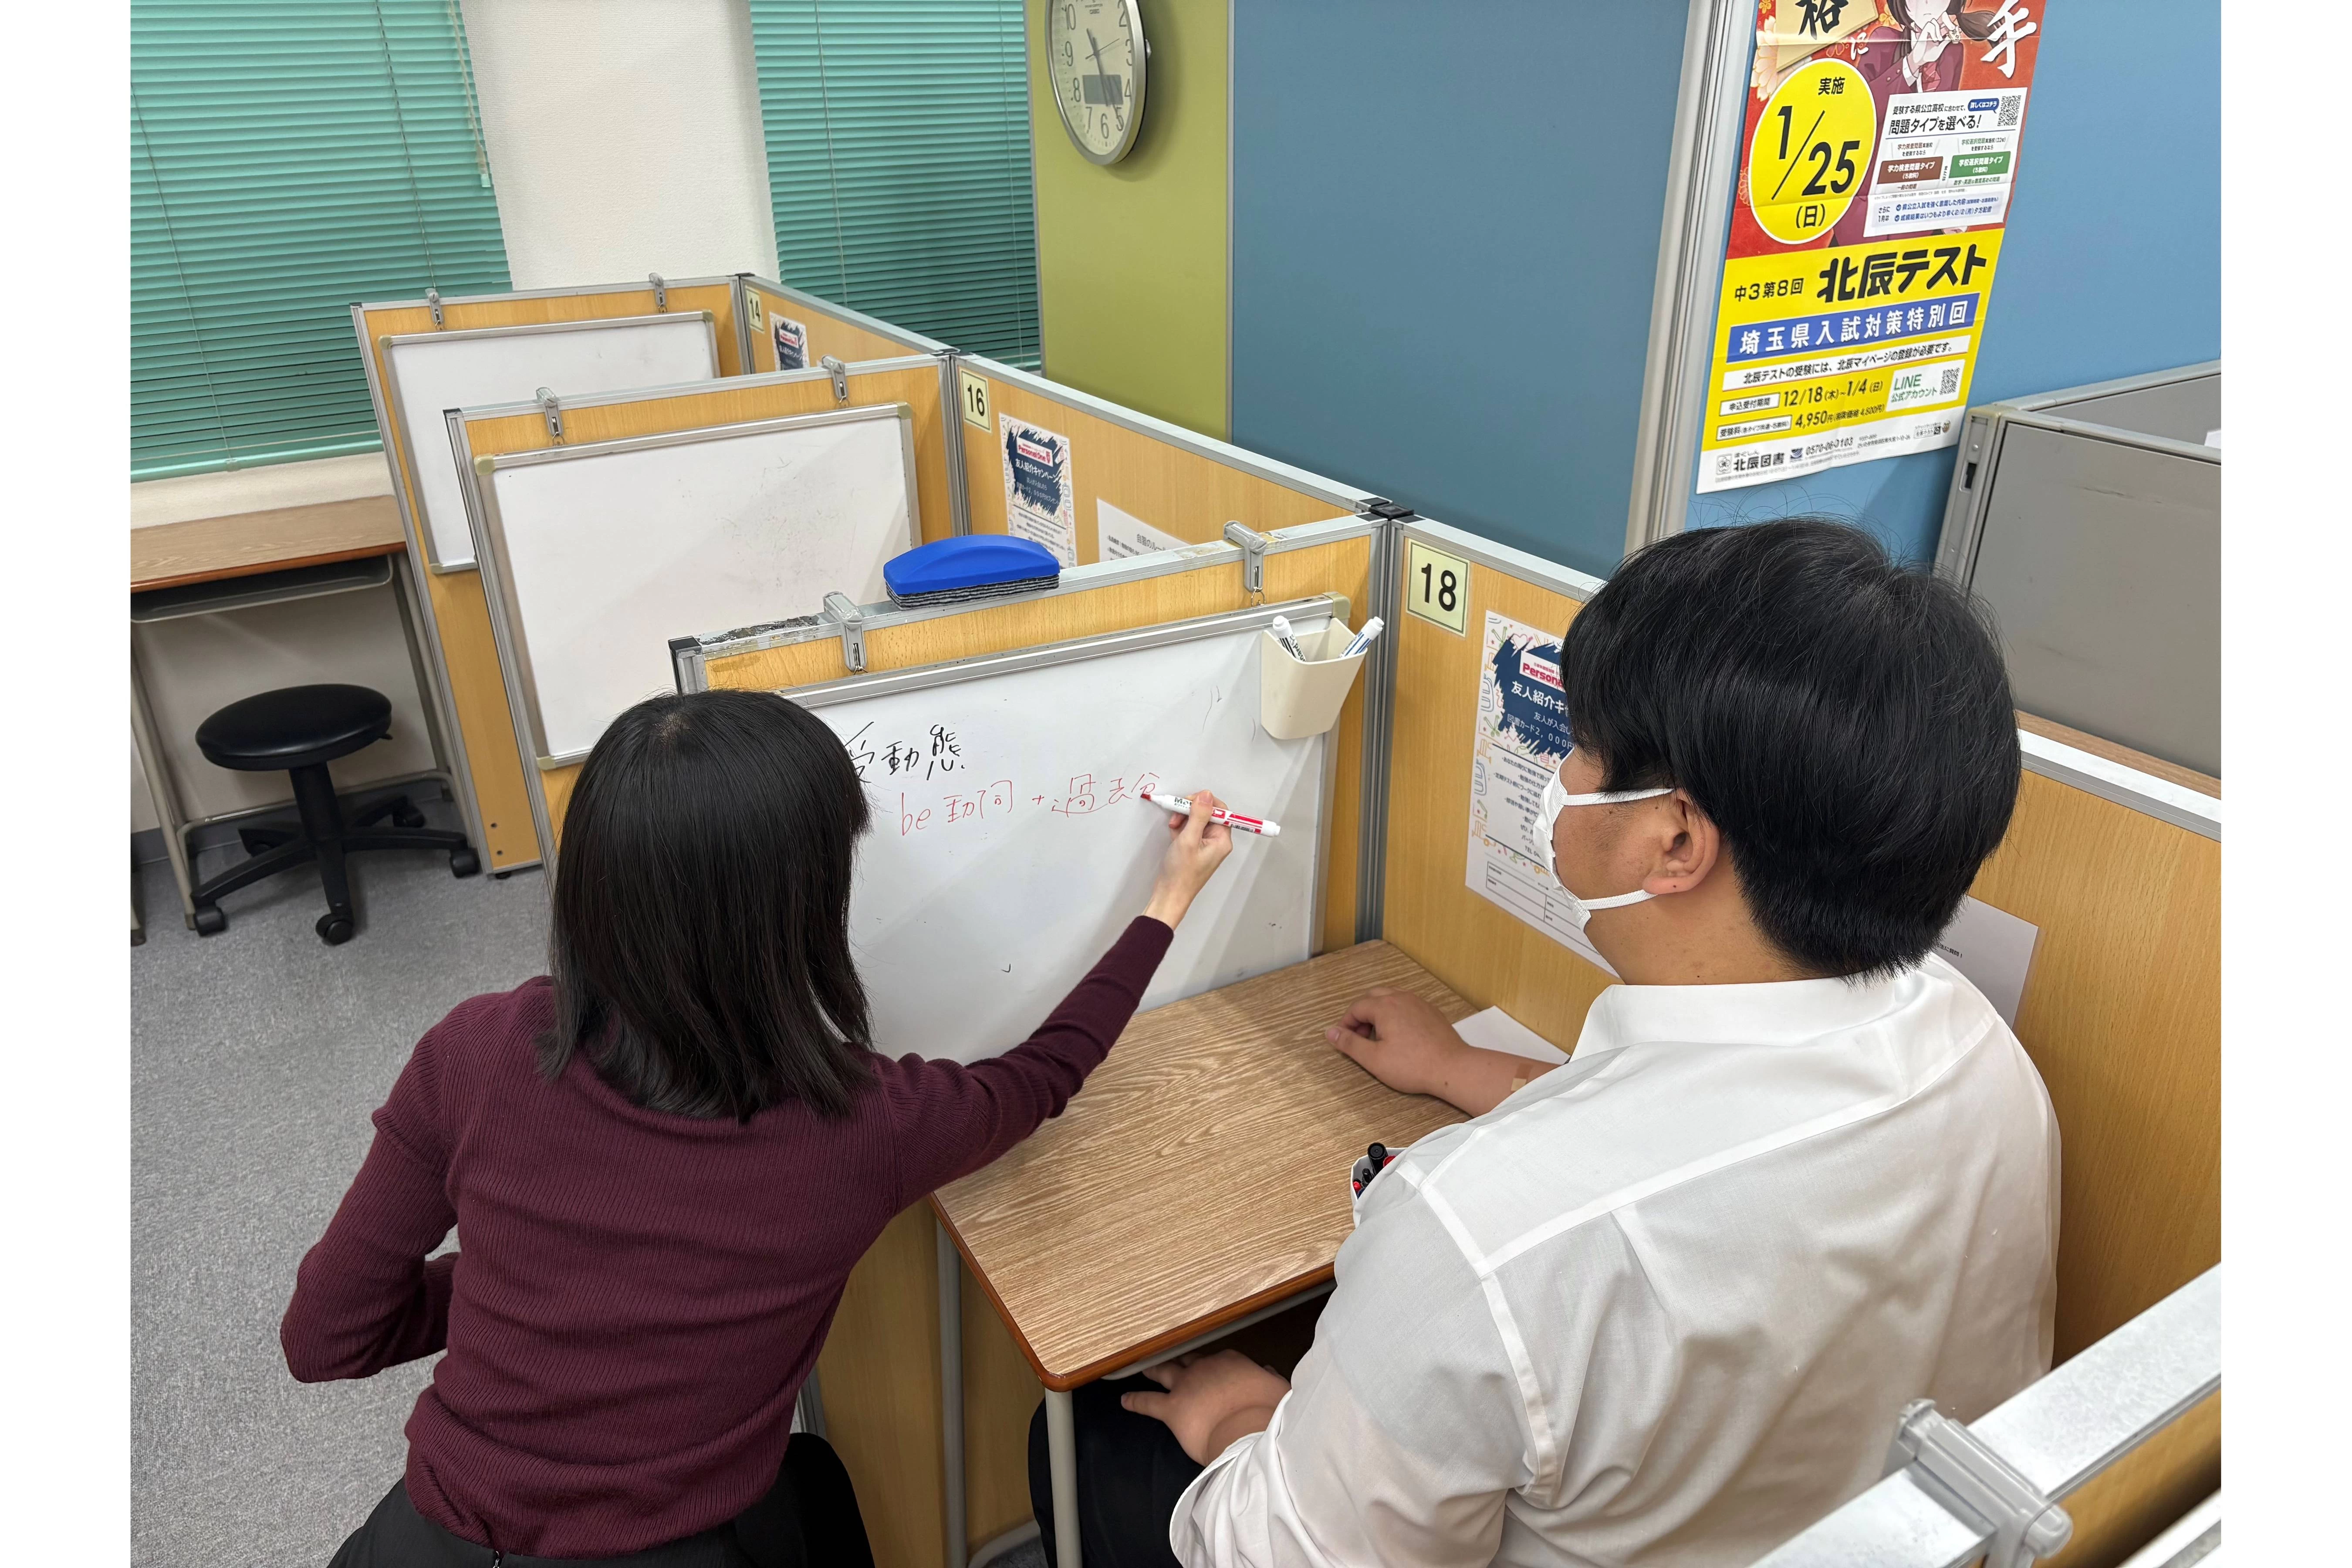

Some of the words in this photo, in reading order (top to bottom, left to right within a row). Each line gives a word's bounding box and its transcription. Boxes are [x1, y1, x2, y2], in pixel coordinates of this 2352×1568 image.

[1850, 32, 1869, 60] に
[1073, 78, 1081, 102] 8
[1818, 77, 1845, 96] 実施
[1970, 101, 1997, 109] 詳しくはコチラ
[1100, 113, 1109, 139] 6
[1771, 105, 1861, 200] 1/25
[1795, 204, 1826, 230] (日)
[1734, 277, 1804, 303] 中3第8回
[1816, 243, 1987, 303] 北辰テスト
[750, 297, 761, 321] 14
[1739, 300, 1968, 355] 埼玉県入試対策特別回
[1891, 386, 1938, 403] 公式アカウント
[1894, 374, 1923, 391] LINE
[967, 383, 985, 417] 16
[1733, 452, 1784, 472] 北辰図書
[1421, 563, 1456, 612] 18
[901, 792, 931, 836] be
